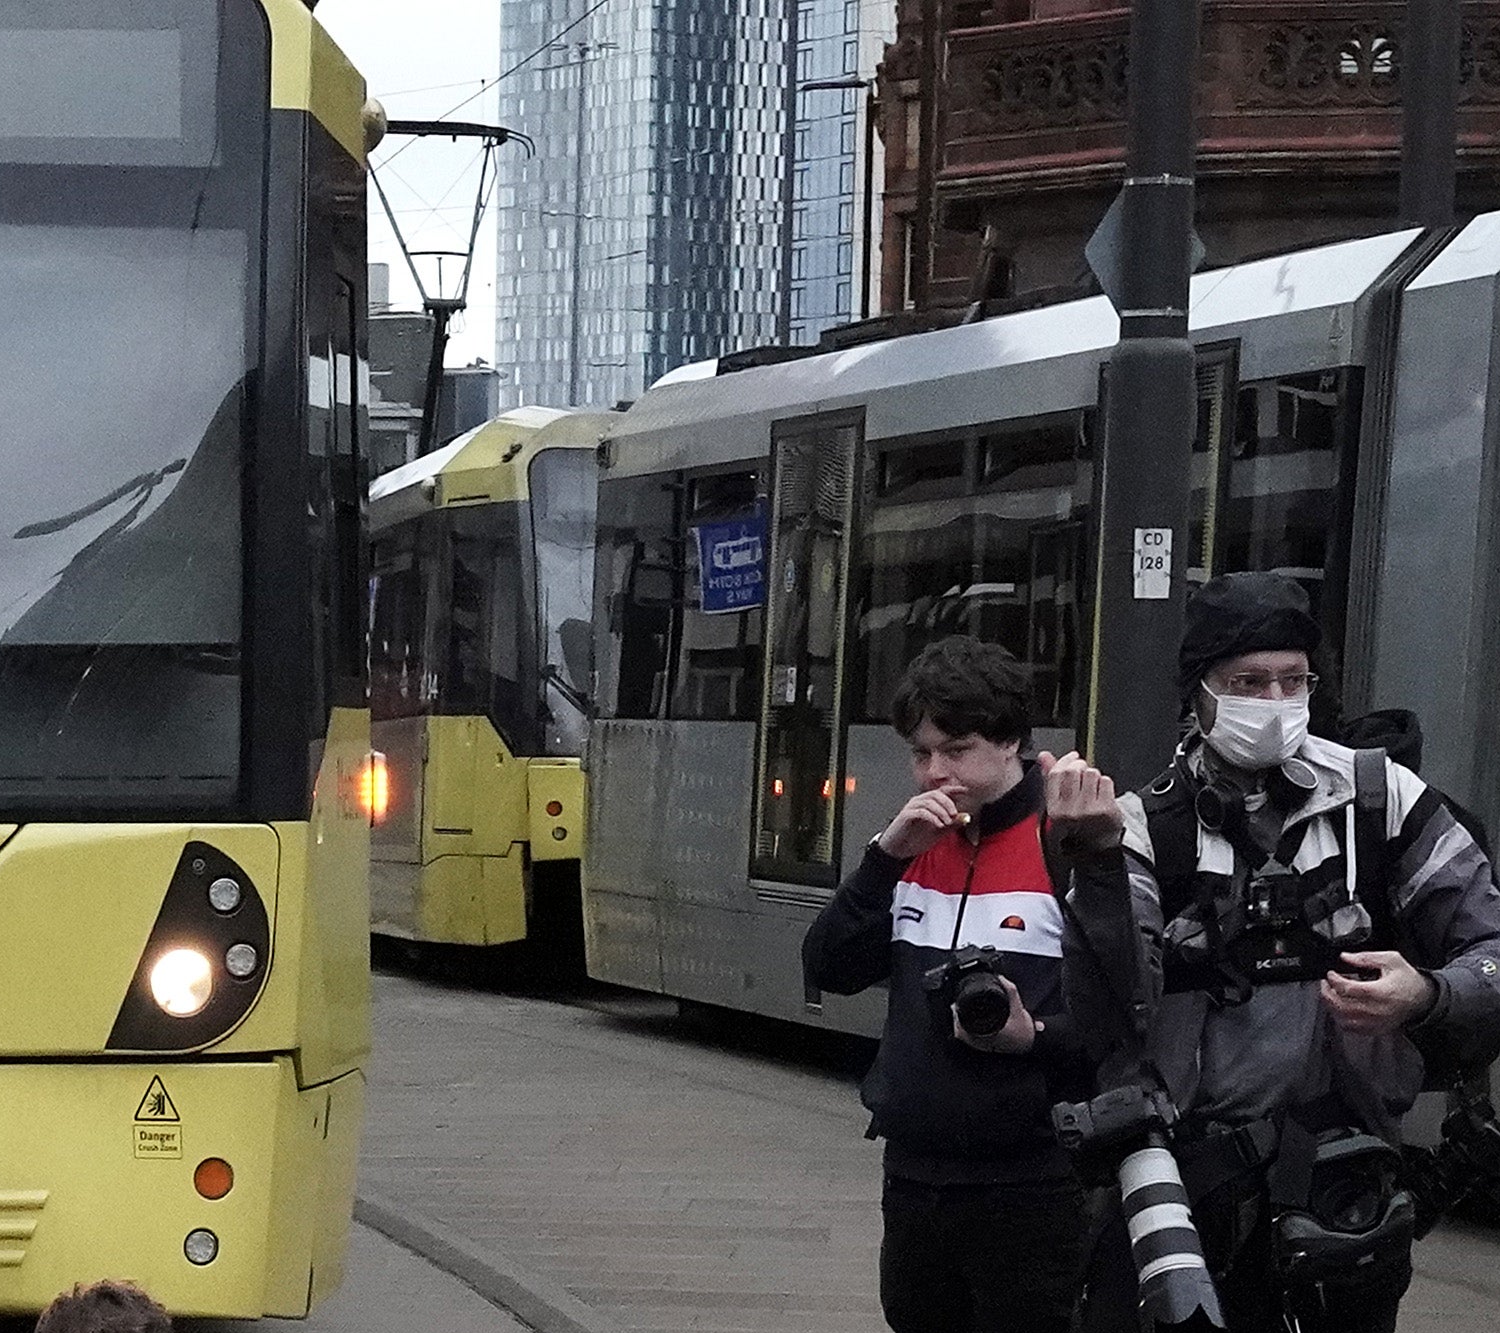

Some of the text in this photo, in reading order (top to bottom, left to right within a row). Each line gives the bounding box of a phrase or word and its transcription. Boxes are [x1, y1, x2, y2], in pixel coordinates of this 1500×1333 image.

[1143, 533, 1163, 546] CD
[1140, 556, 1164, 570] 128
[139, 1131, 176, 1143] Danger
